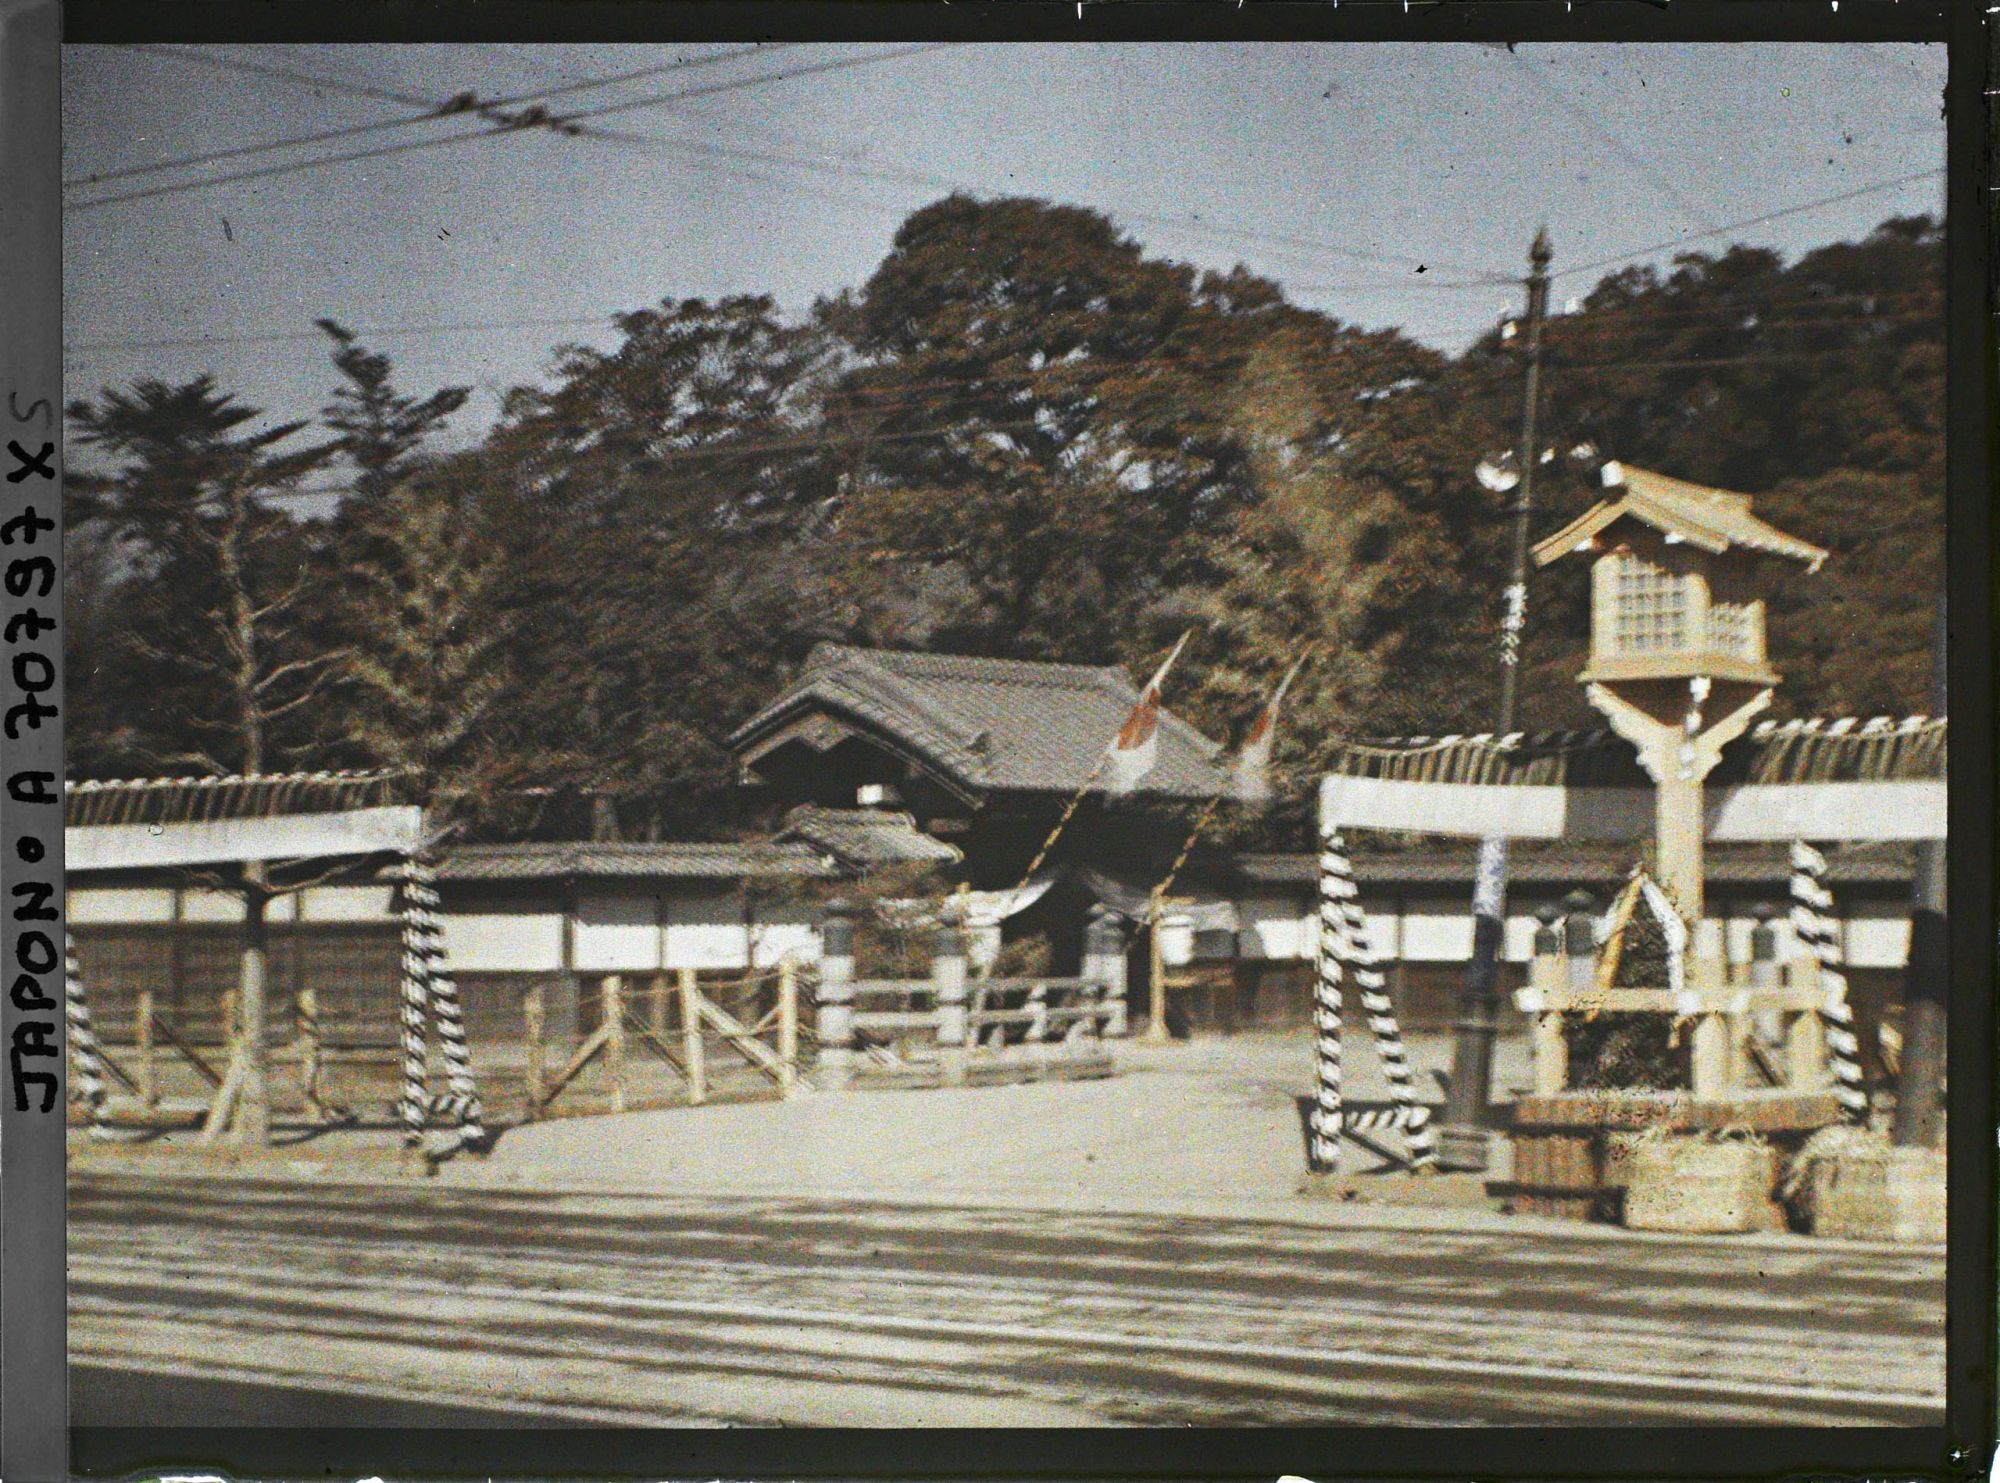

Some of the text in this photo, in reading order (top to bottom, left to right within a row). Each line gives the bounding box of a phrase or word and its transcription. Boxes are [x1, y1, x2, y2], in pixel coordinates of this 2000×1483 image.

[1, 506, 58, 740] 70797
[7, 771, 57, 804] A
[10, 882, 58, 1112] JAPON
